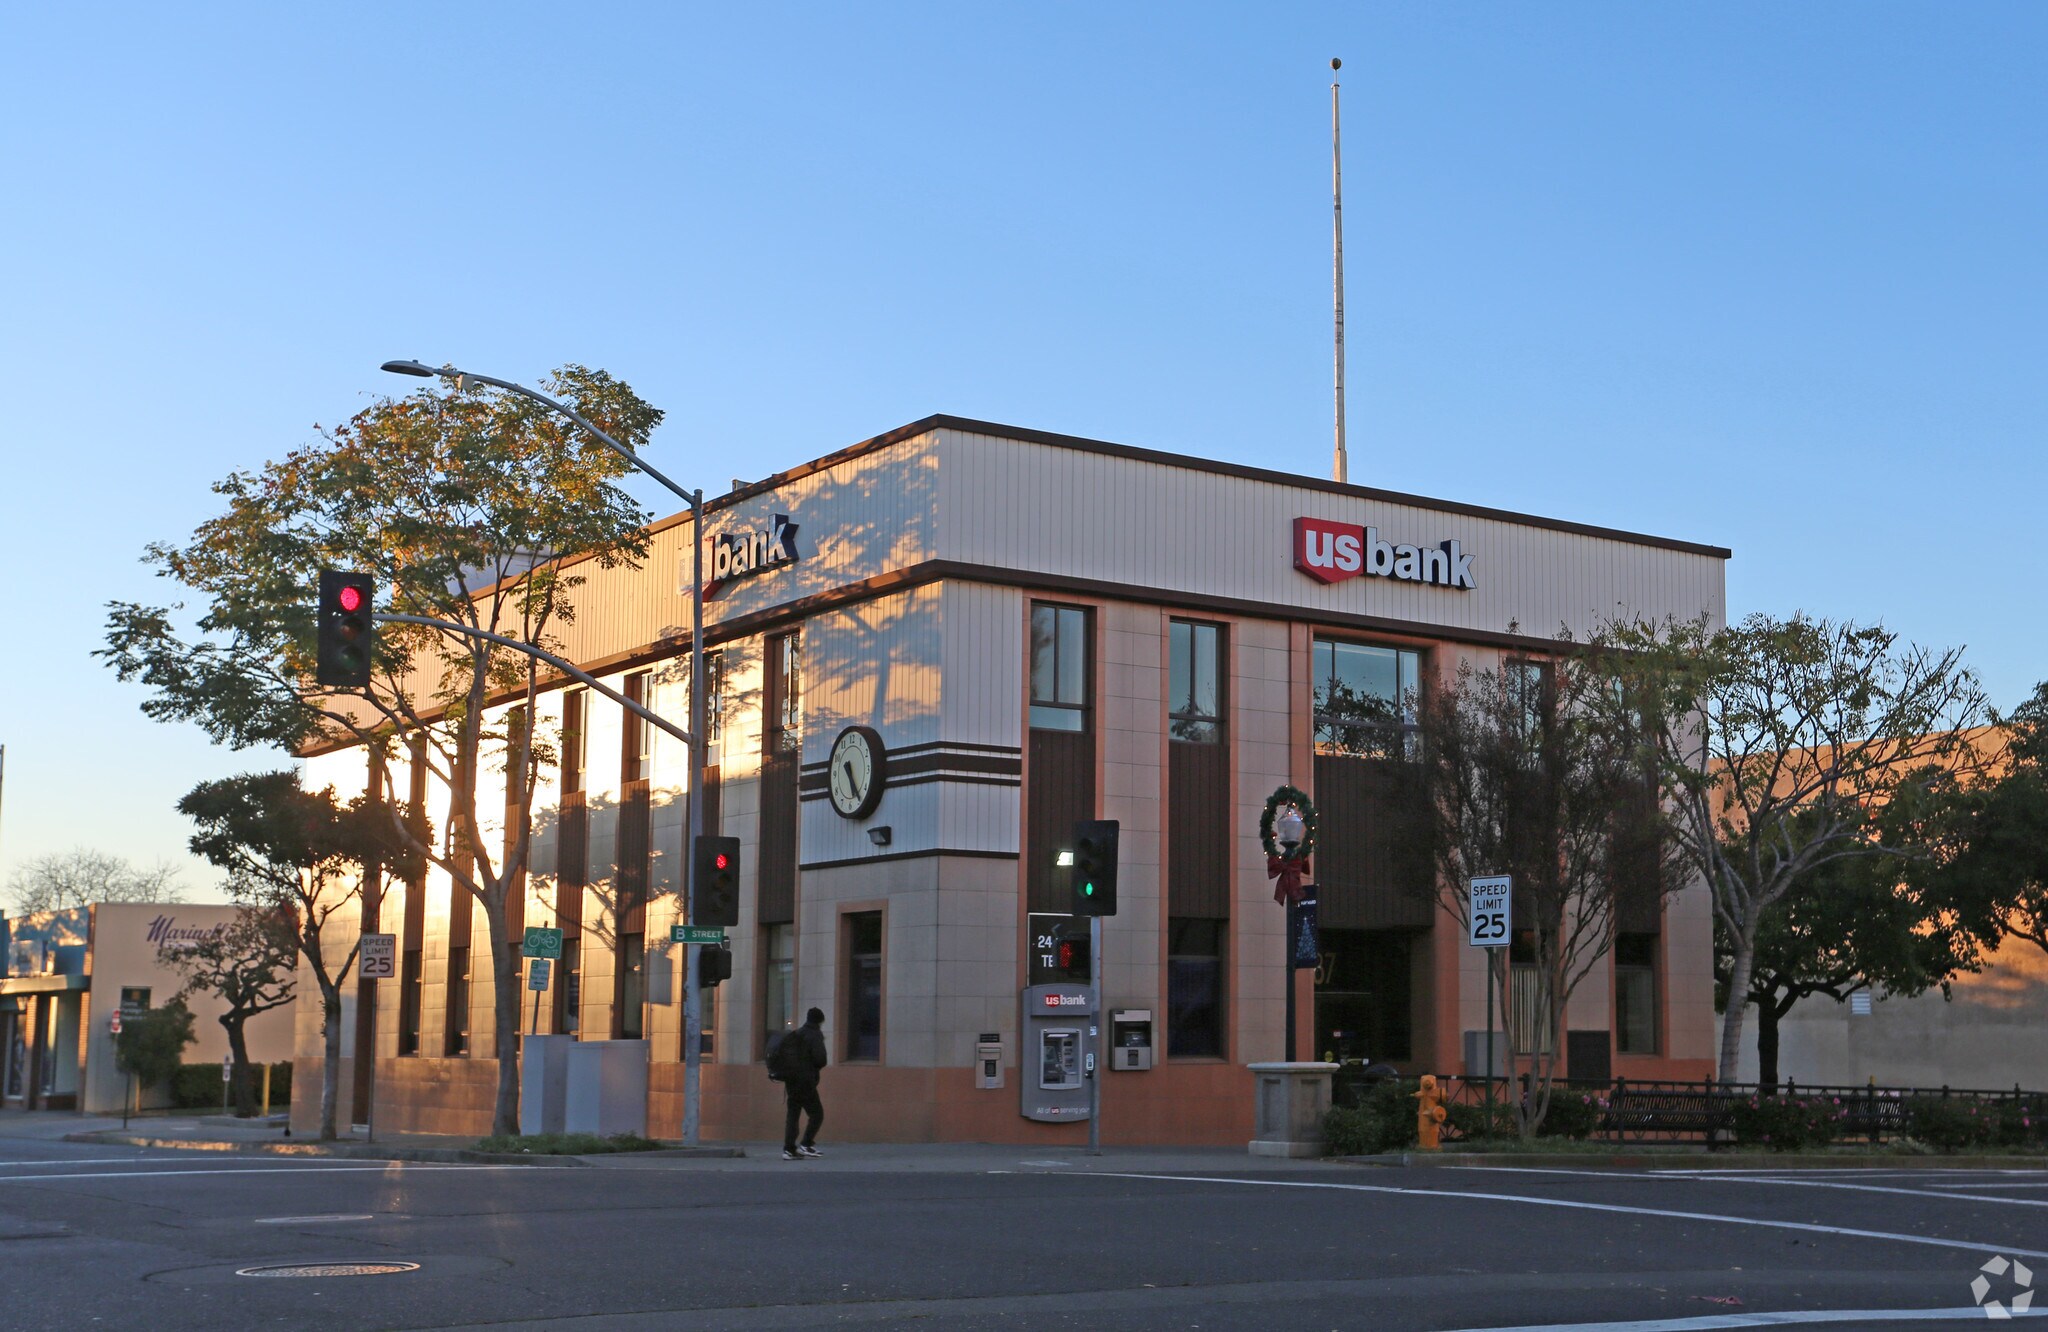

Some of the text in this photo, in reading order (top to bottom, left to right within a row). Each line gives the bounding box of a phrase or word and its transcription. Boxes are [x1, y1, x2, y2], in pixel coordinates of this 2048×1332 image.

[1473, 884, 1508, 897] SPEED
[1476, 898, 1503, 910] LIMIT
[1474, 913, 1506, 939] 25
[676, 927, 722, 940] B STREET
[363, 938, 394, 946] SPEED
[1037, 935, 1053, 948] 24
[365, 947, 389, 955] LIMIT
[363, 956, 391, 973] 25
